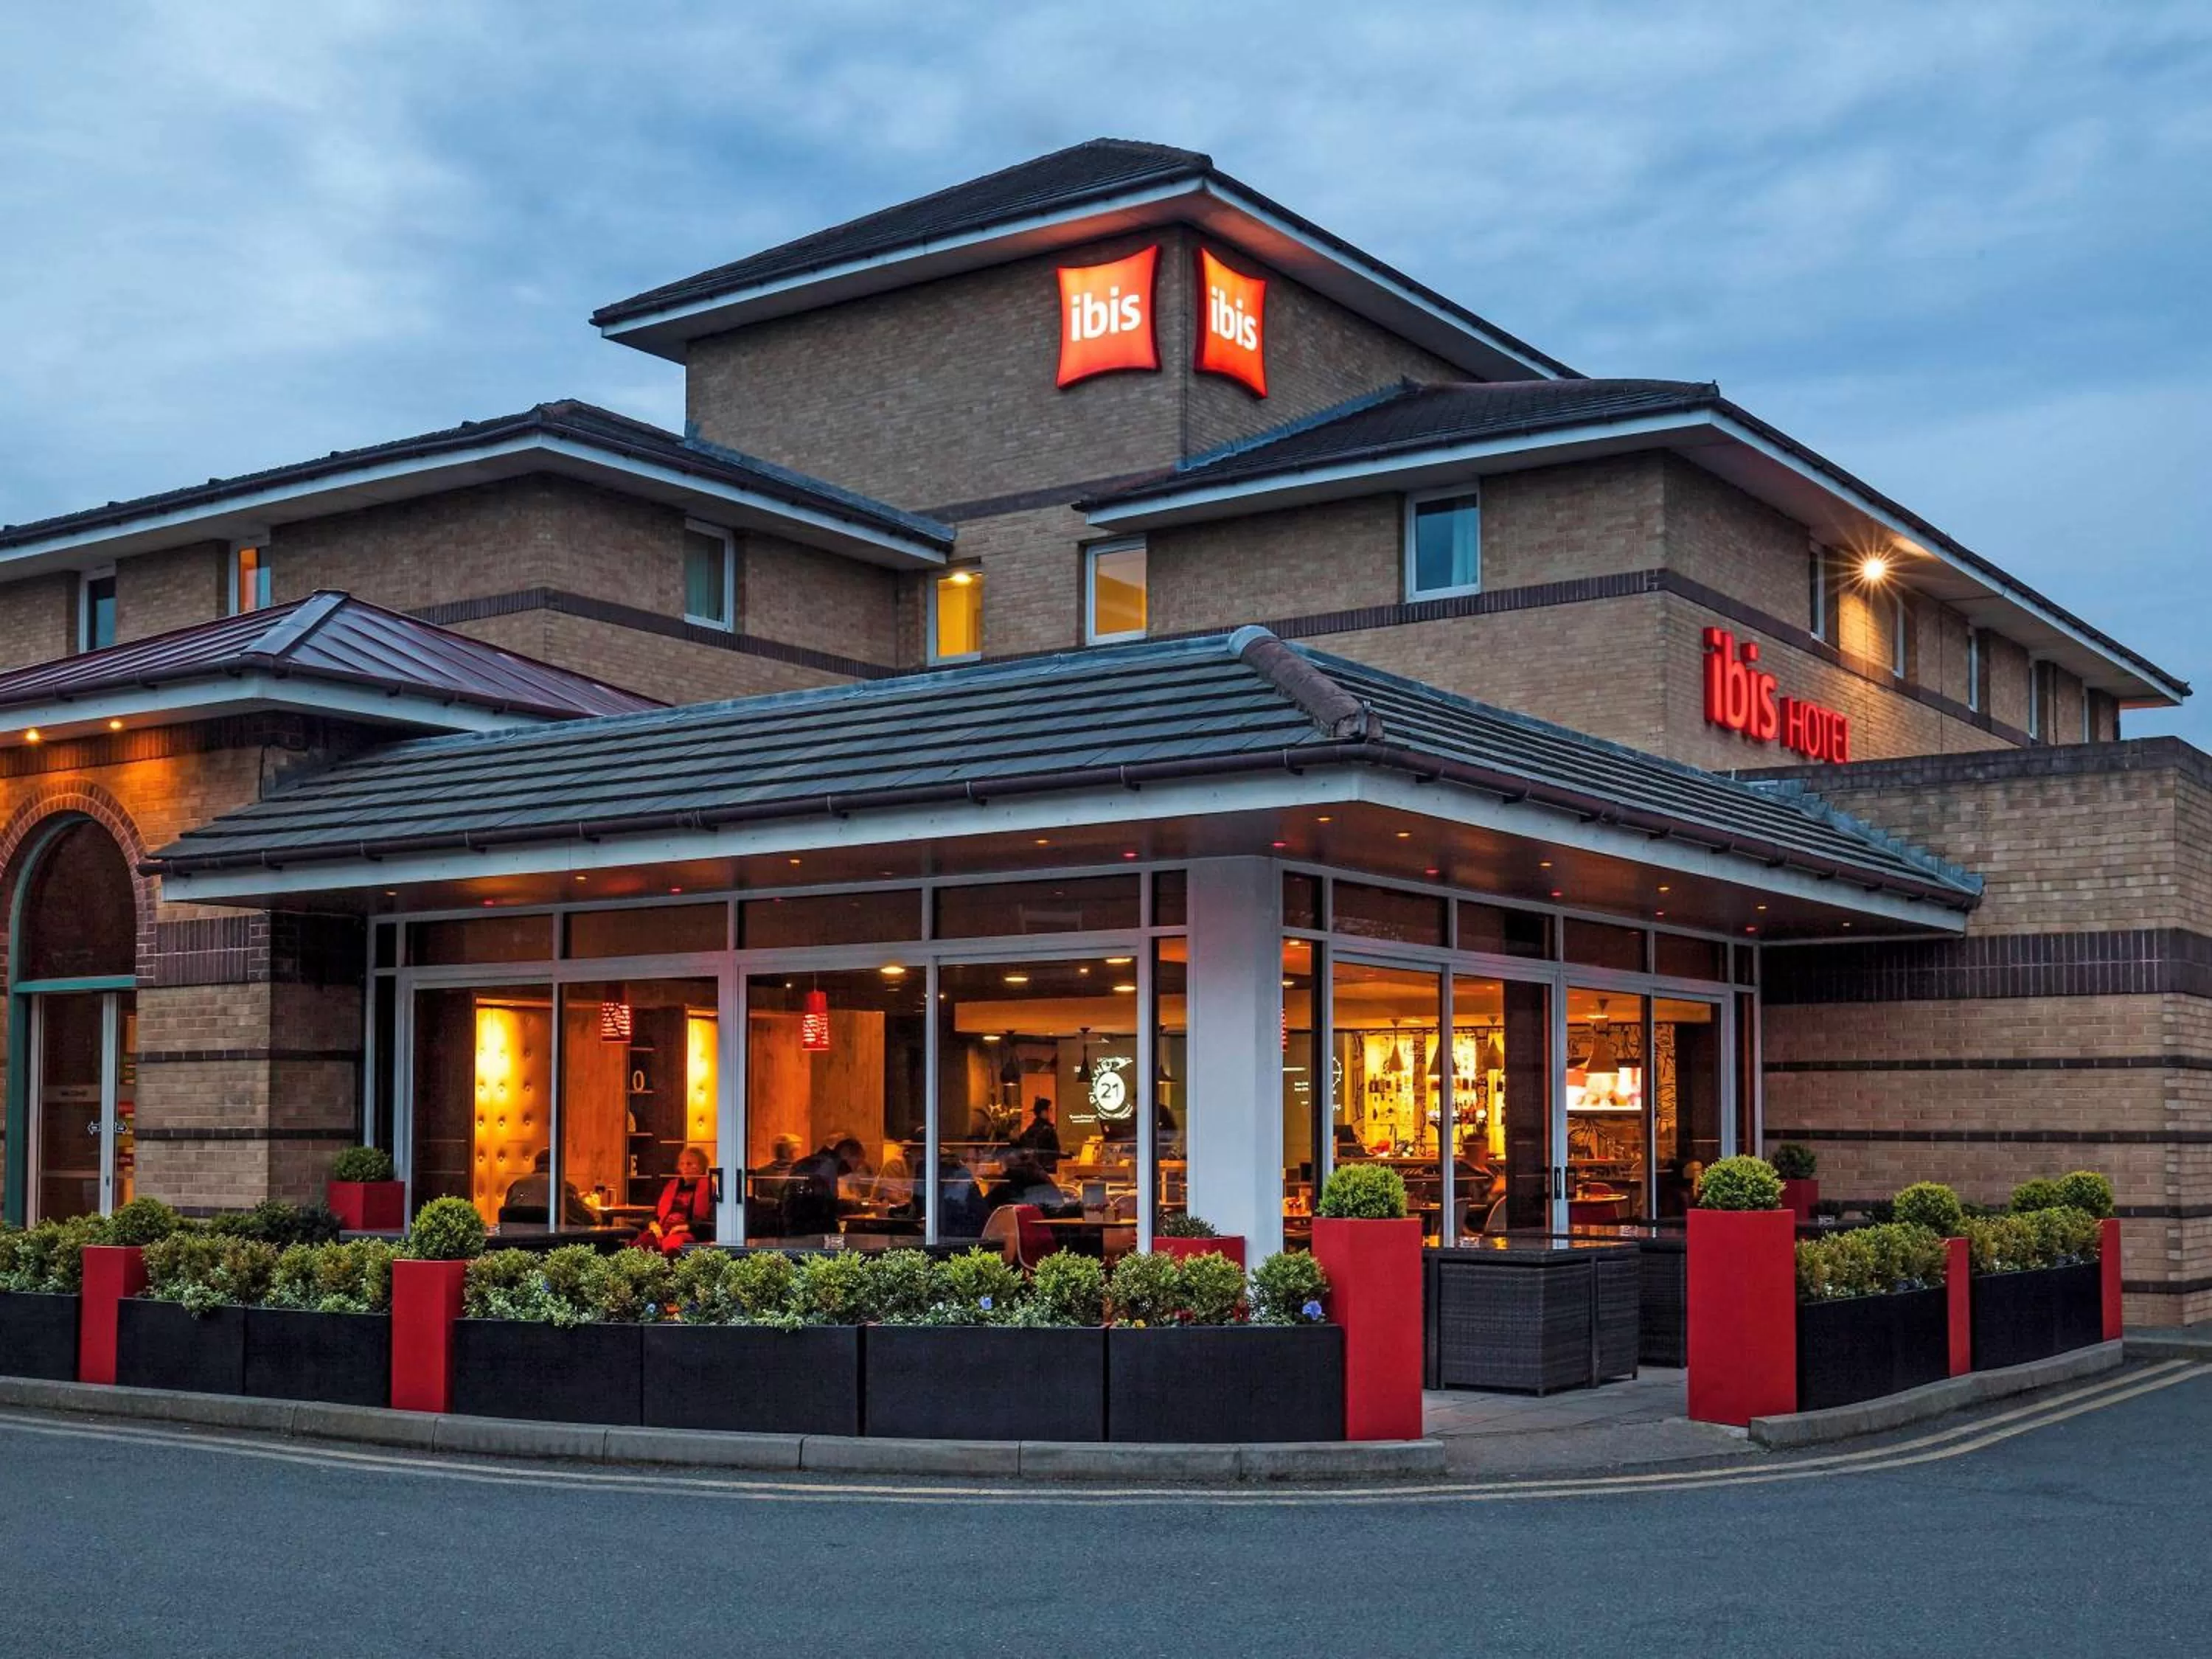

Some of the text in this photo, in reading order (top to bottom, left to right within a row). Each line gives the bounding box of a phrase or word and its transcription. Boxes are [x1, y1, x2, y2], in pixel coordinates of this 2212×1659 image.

[1071, 286, 1141, 341] ibis
[1211, 285, 1257, 351] ibis
[1705, 627, 1778, 740] ibis
[1101, 1082, 1119, 1099] 21
